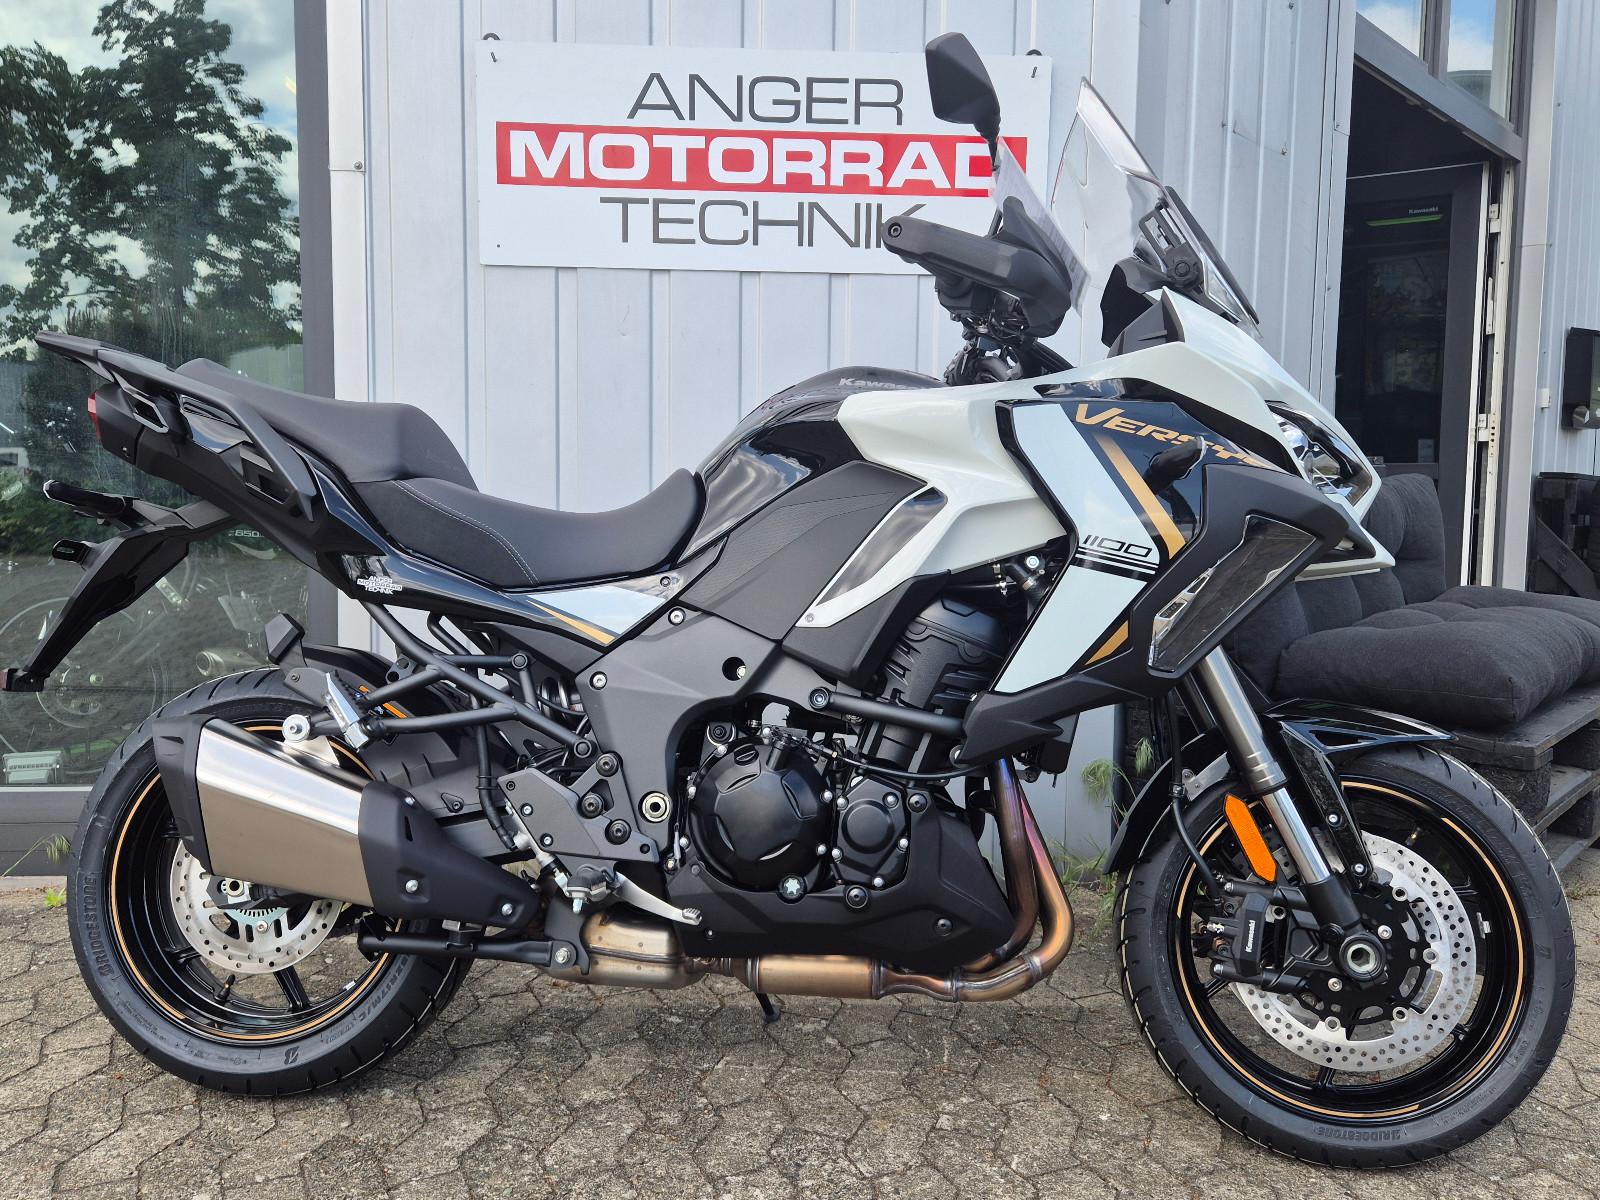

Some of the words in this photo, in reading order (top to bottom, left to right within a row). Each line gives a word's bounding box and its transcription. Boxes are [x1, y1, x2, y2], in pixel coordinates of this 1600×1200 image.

[627, 72, 904, 126] ANGER
[510, 129, 997, 190] MOTORRAD
[600, 196, 927, 250] TECHNIK
[1082, 534, 1153, 558] 1100
[83, 872, 115, 977] BRIDGESTONE
[1245, 919, 1256, 953] Kawasaki
[1316, 1126, 1402, 1141] BRIDGESTONE
